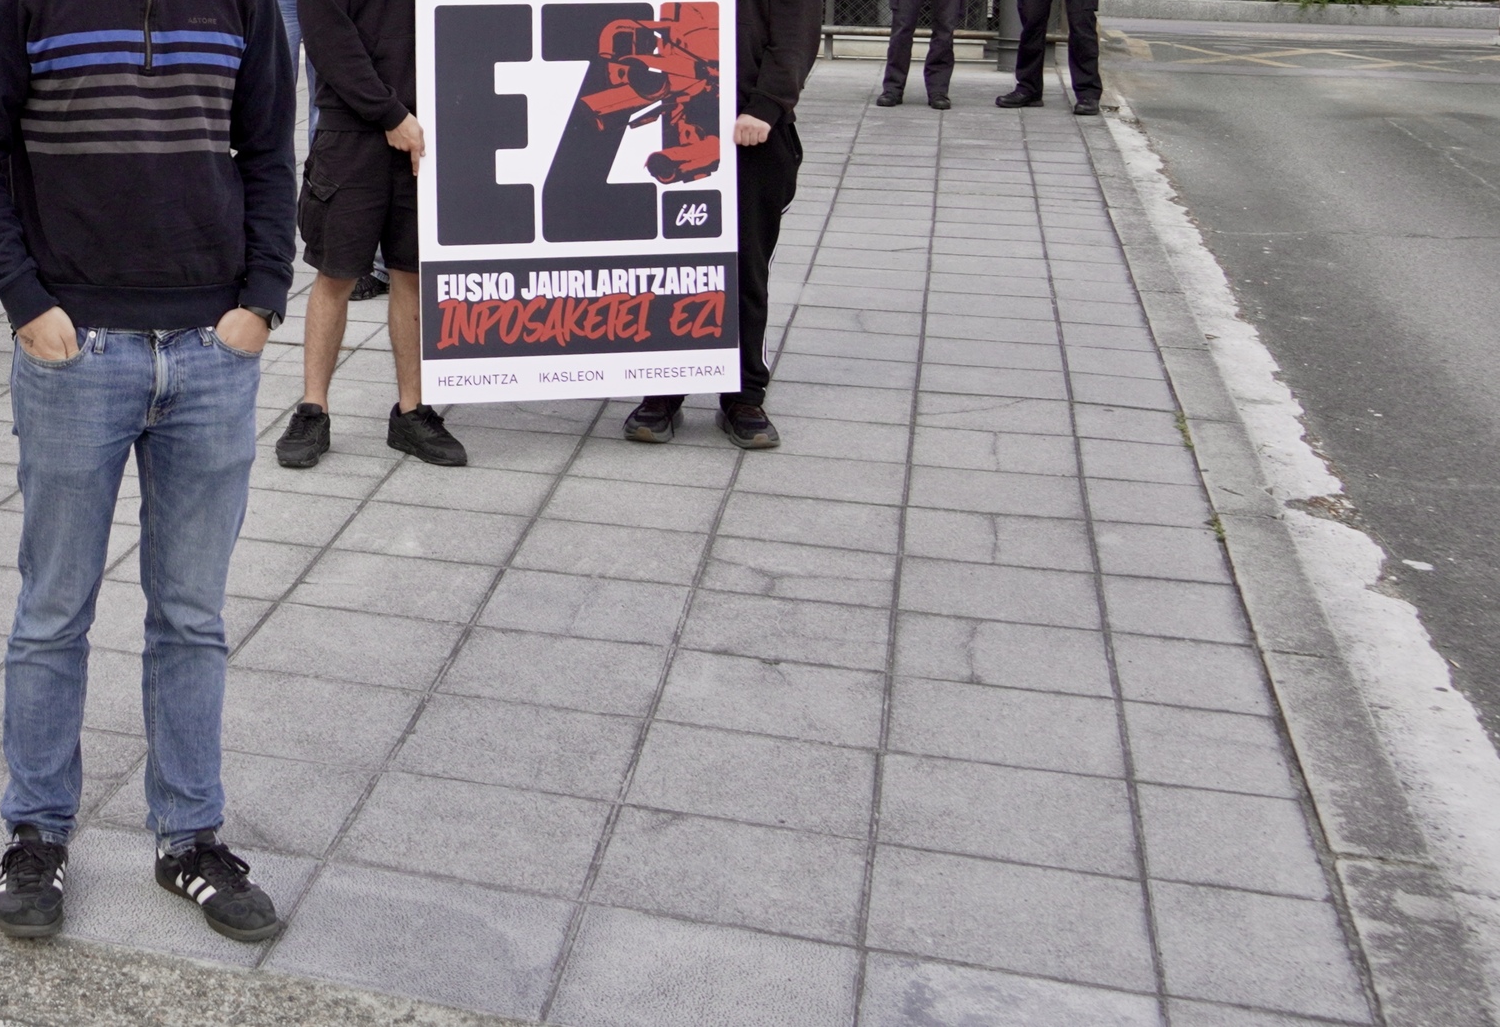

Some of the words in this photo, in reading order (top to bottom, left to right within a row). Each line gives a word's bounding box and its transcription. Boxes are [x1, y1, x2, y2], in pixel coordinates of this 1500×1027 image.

[437, 272, 515, 302] EUSKO
[520, 265, 726, 300] JAURLARITZAREN
[436, 291, 656, 350] INPOSAKETEI
[668, 290, 726, 339] EZ!
[437, 373, 518, 388] HEZKUNTZA
[538, 370, 605, 384] IKASLEON
[624, 365, 726, 380] INTERESETARA!
